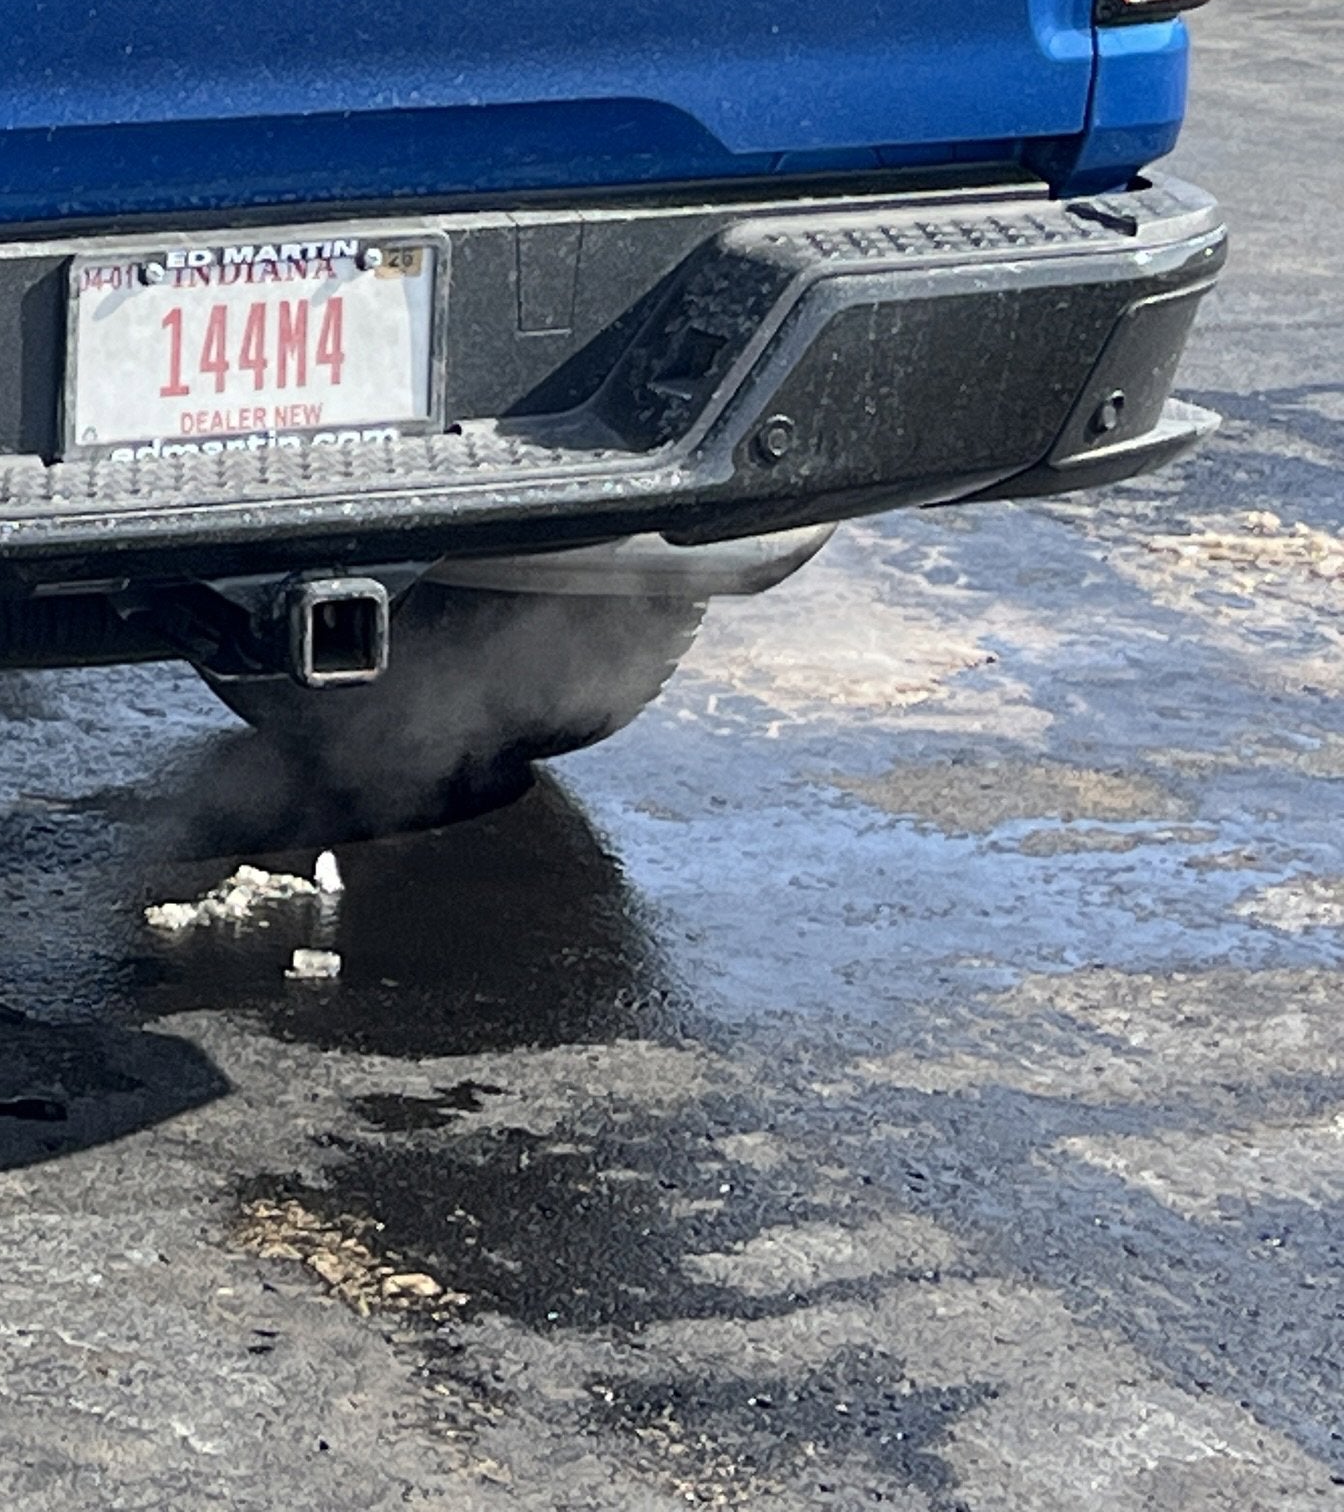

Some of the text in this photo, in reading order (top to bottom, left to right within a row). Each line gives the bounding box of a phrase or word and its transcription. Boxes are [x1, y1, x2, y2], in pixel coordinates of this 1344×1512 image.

[166, 240, 359, 268] ED MARTIN
[174, 257, 337, 288] INDIANA
[159, 296, 346, 398] 144M4
[179, 402, 324, 435] DEALER NEW
